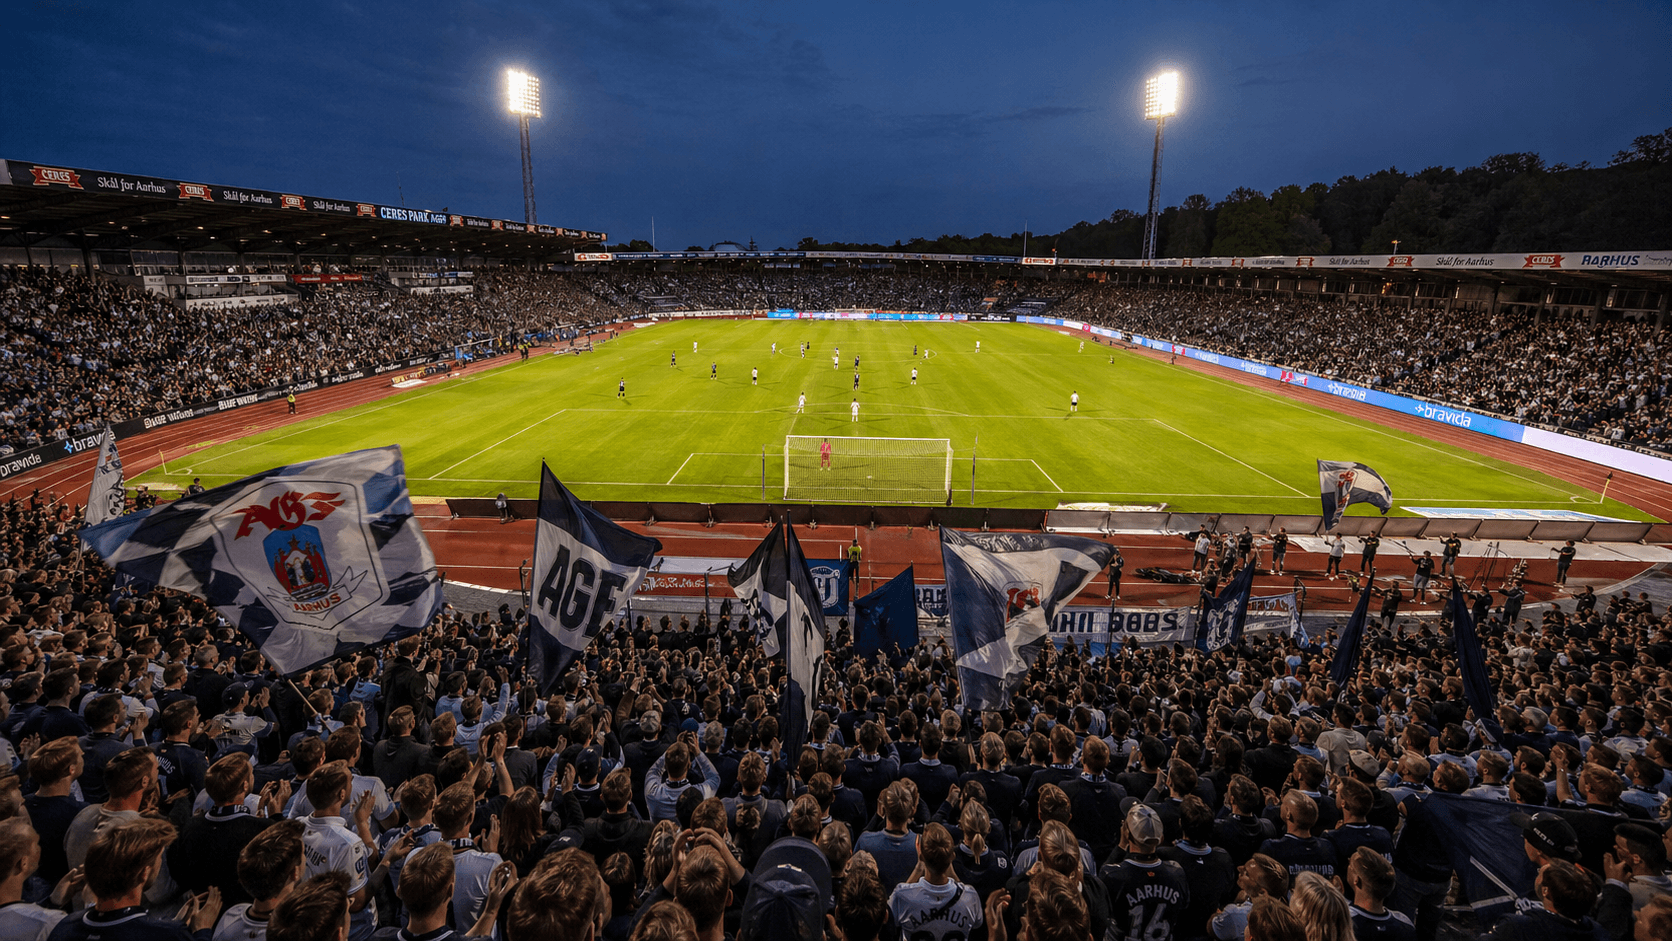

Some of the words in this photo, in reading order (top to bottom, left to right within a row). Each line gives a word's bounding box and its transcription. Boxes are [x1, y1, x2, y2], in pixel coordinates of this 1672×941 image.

[120, 178, 135, 192] for
[380, 206, 408, 221] CERES
[408, 210, 430, 223] PARK
[1125, 883, 1180, 907] AARHUS
